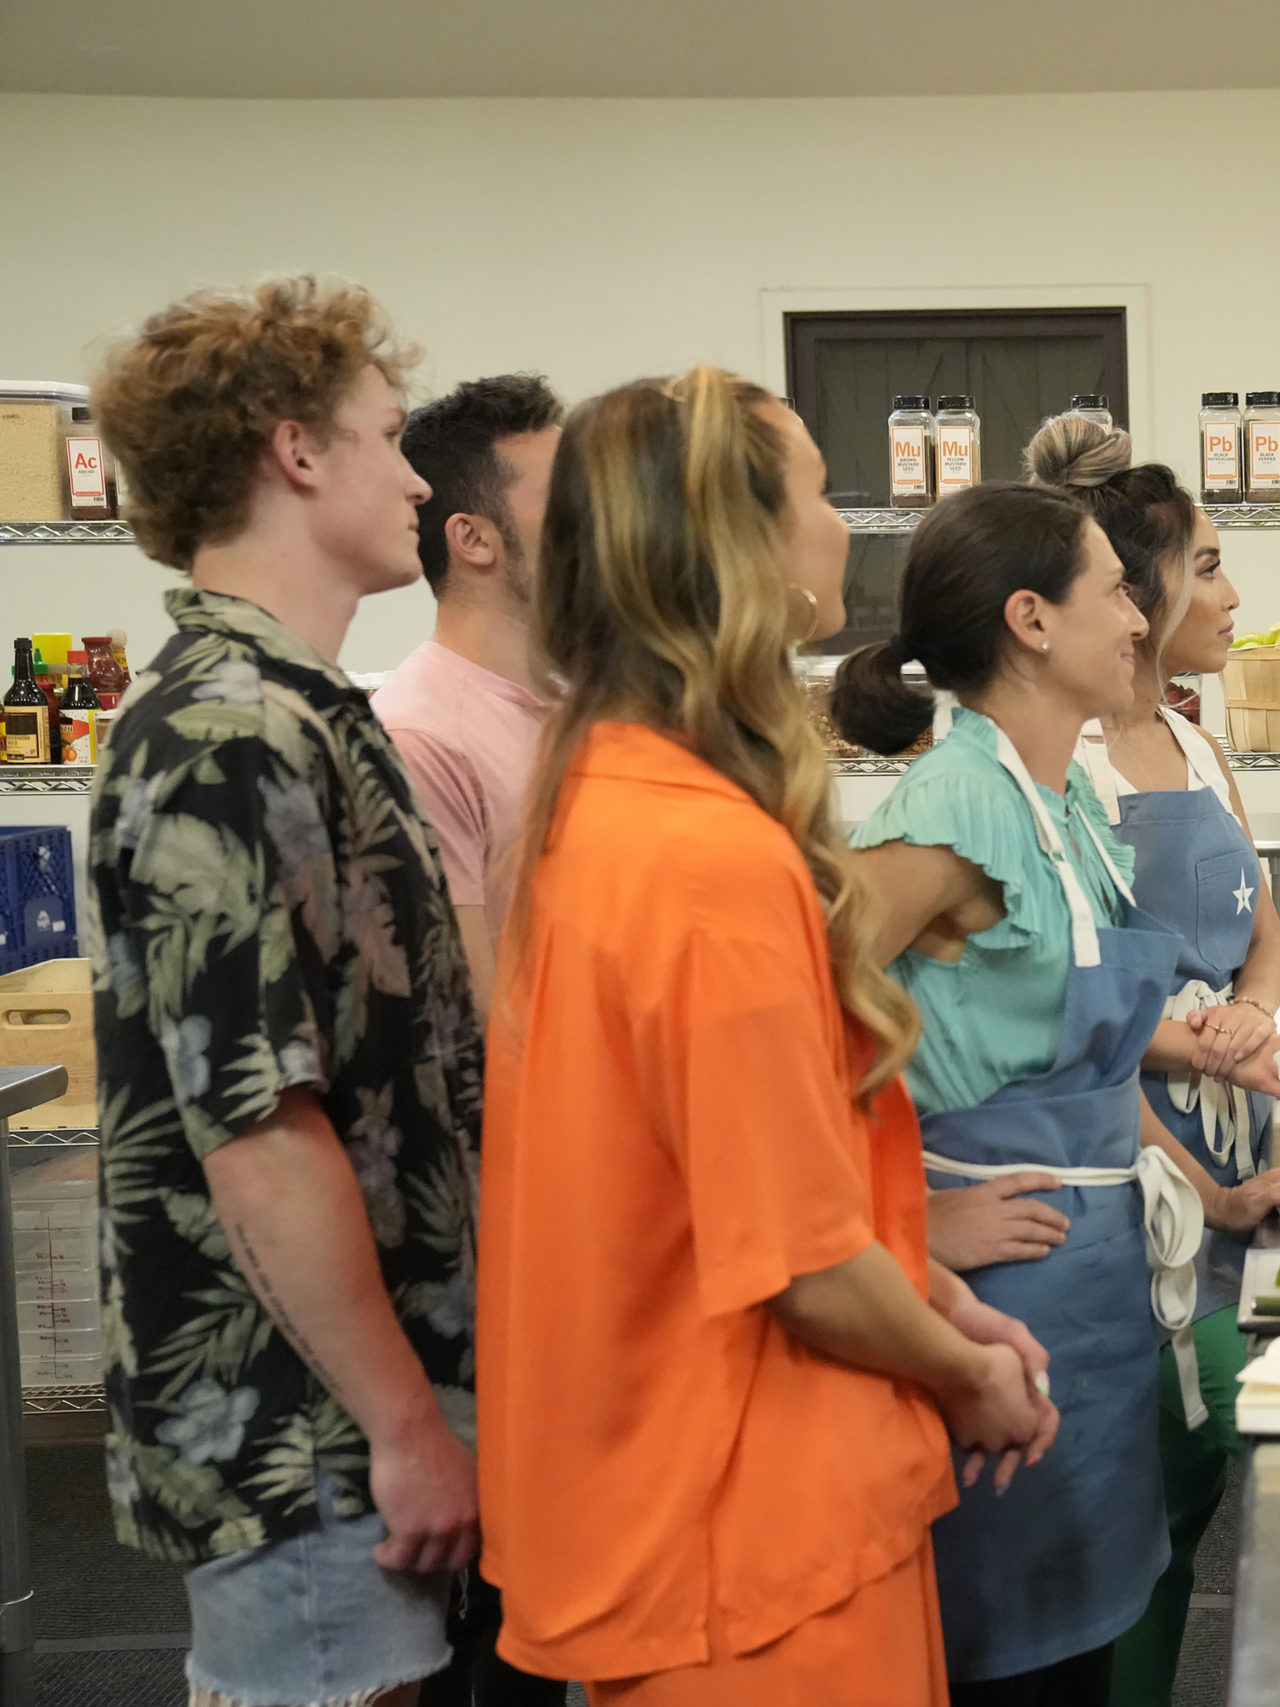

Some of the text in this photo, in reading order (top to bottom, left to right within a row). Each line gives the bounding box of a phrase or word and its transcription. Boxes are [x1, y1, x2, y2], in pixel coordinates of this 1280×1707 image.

[895, 441, 921, 457] Mu
[943, 441, 968, 456] Mu
[1209, 436, 1233, 452] Pb
[1255, 436, 1279, 452] Pb
[75, 453, 98, 469] Ac
